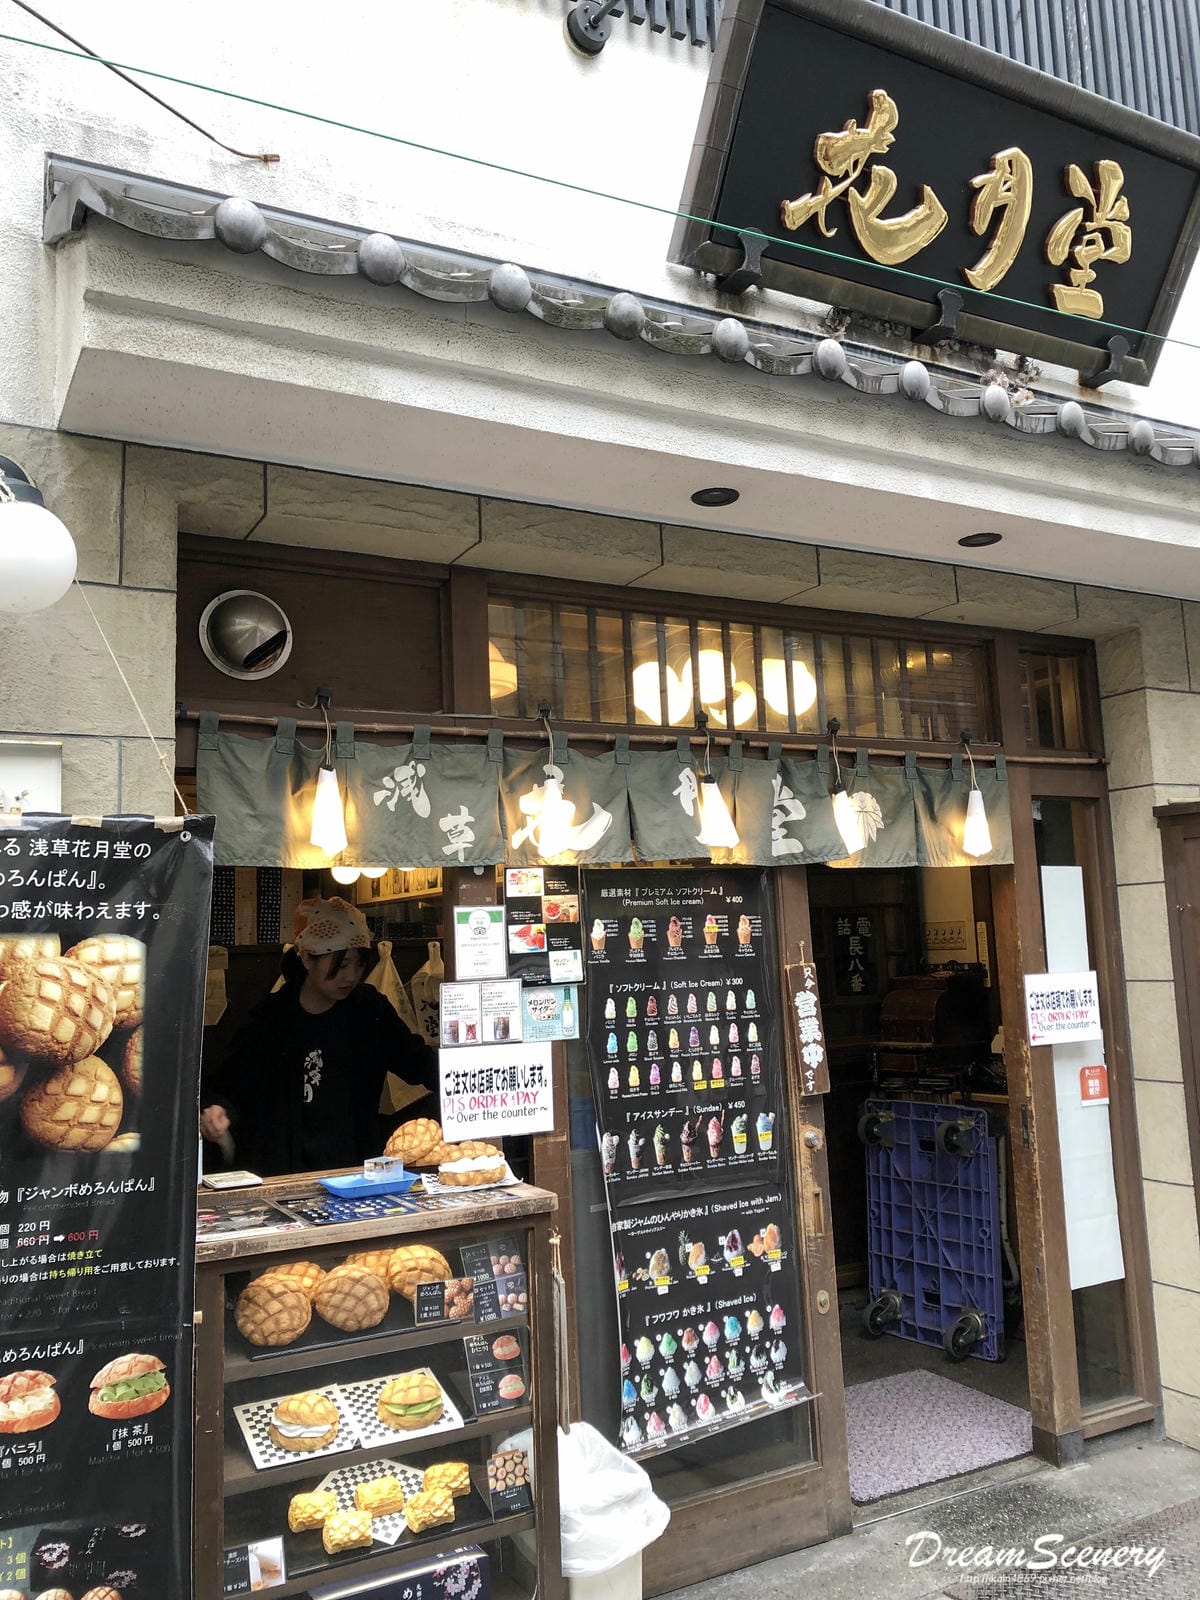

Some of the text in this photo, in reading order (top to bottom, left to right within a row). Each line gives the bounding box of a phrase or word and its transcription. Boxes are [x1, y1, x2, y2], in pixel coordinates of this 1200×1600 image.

[780, 88, 1132, 319] 花月堂
[29, 838, 151, 859] 浅草花月堂の
[655, 897, 669, 906] Soft
[670, 898, 680, 906] Ice
[688, 980, 698, 989] Ice
[726, 977, 743, 985] ¥300
[1075, 1010, 1089, 1020] PAY
[794, 967, 825, 1092] 只今営業中です
[1056, 1022, 1066, 1030] the
[445, 1064, 547, 1097] ご注文は店頭でお願いします。
[443, 1096, 465, 1114] PLS
[469, 1092, 508, 1111] ORDER
[517, 1090, 539, 1105] PAY
[728, 1100, 746, 1110] ¥450
[483, 1109, 498, 1119] the
[16, 1176, 155, 1203] 『ジャンボめろんぱん』
[17, 1222, 37, 1233] 220
[39, 1220, 50, 1231] 円
[67, 1231, 85, 1242] 600
[88, 1229, 99, 1240] 円
[0, 1339, 84, 1364] めろんぱん』
[128, 1437, 142, 1448] 500
[18, 1456, 34, 1466] 500
[36, 1453, 46, 1464] 円
